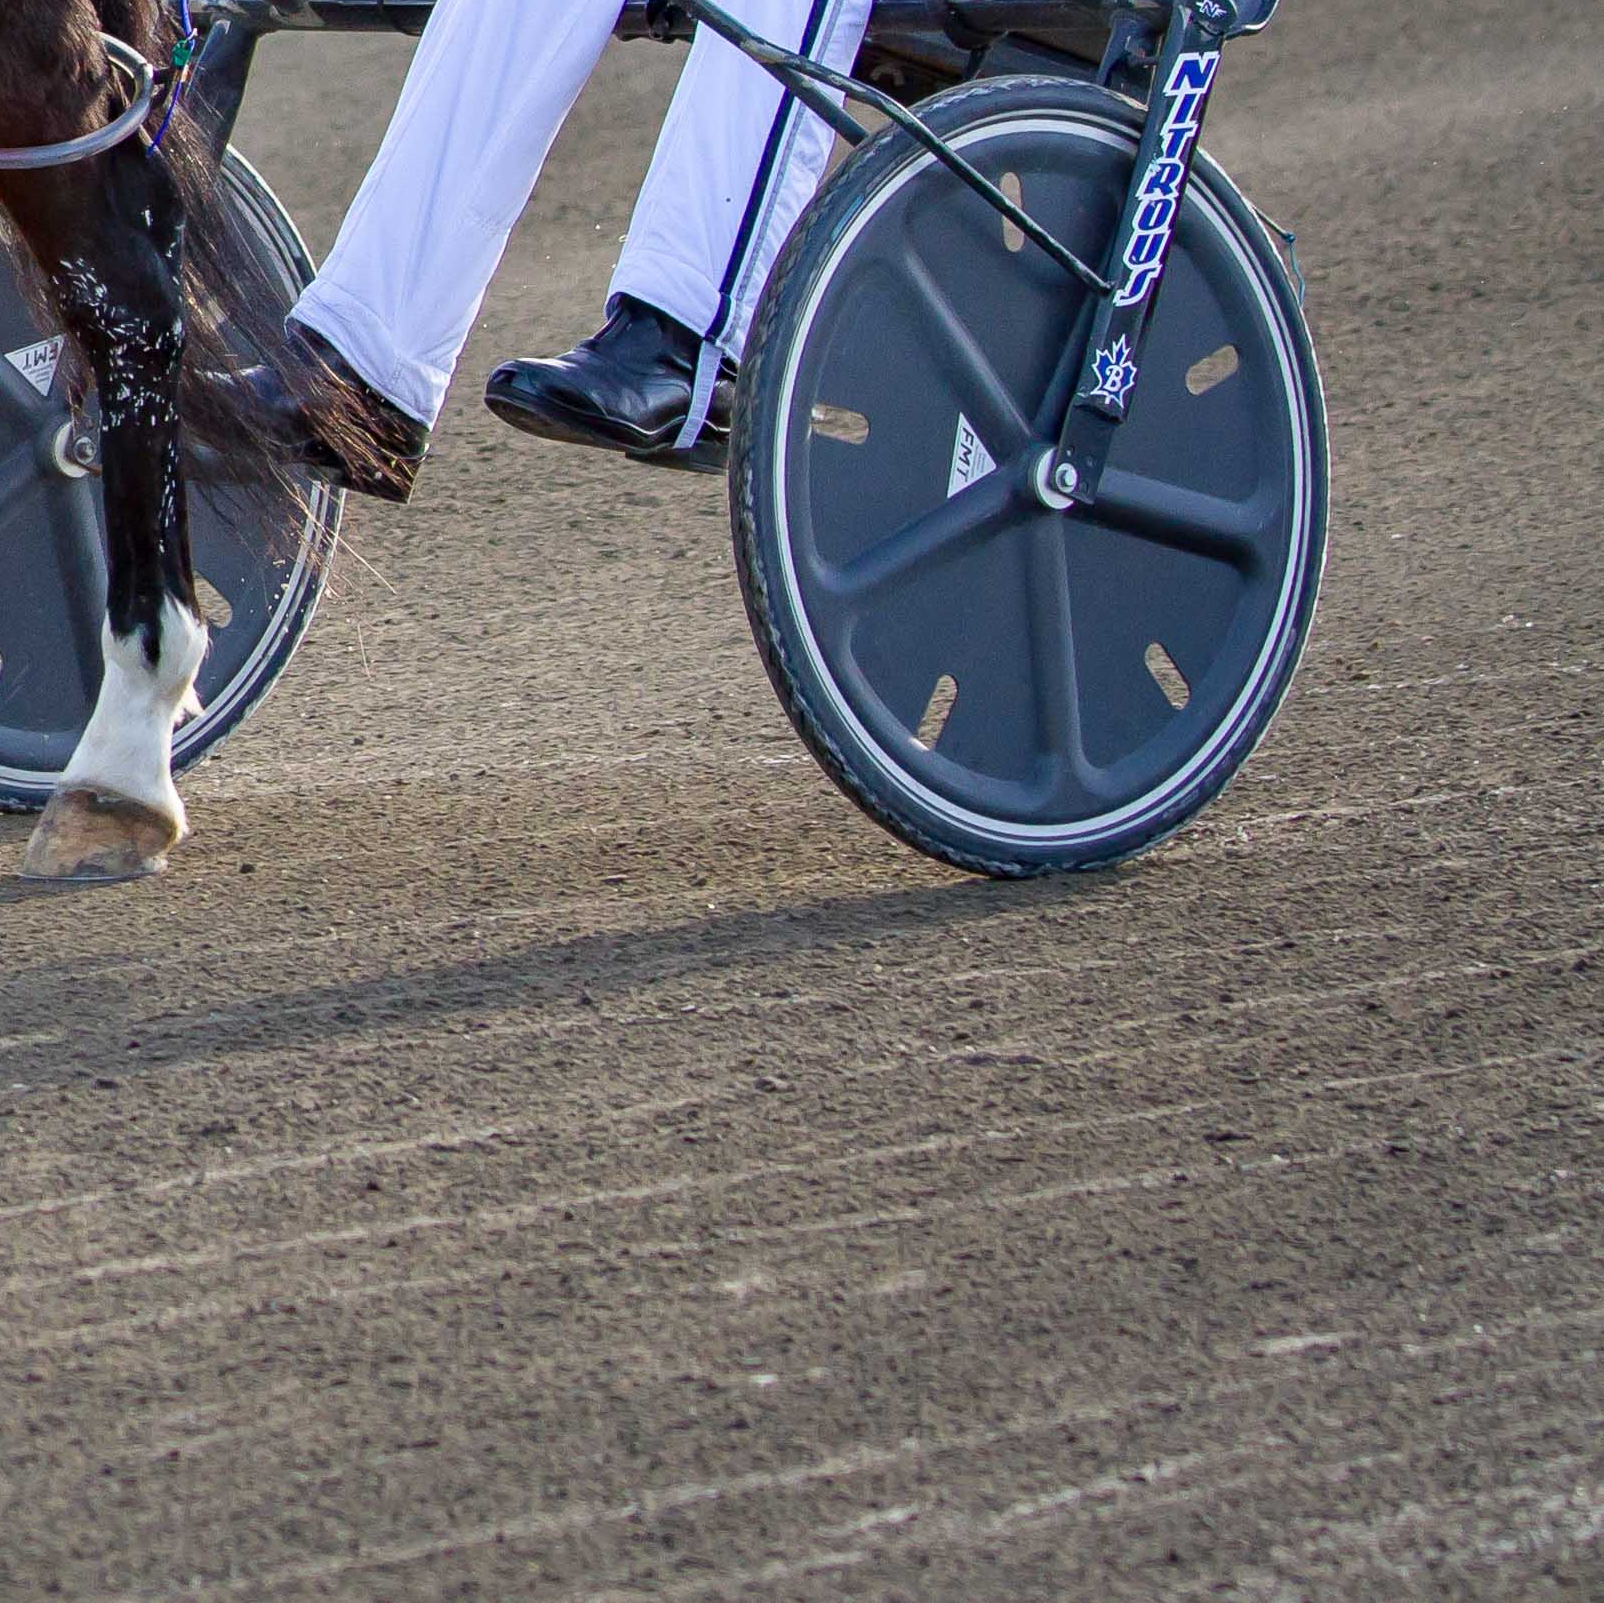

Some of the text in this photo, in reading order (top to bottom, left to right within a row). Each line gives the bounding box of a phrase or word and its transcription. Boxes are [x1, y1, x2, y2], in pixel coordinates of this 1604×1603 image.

[1113, 52, 1221, 306] NITROUS
[22, 342, 59, 371] FMT
[1103, 364, 1124, 392] B
[956, 427, 975, 483] FMT
